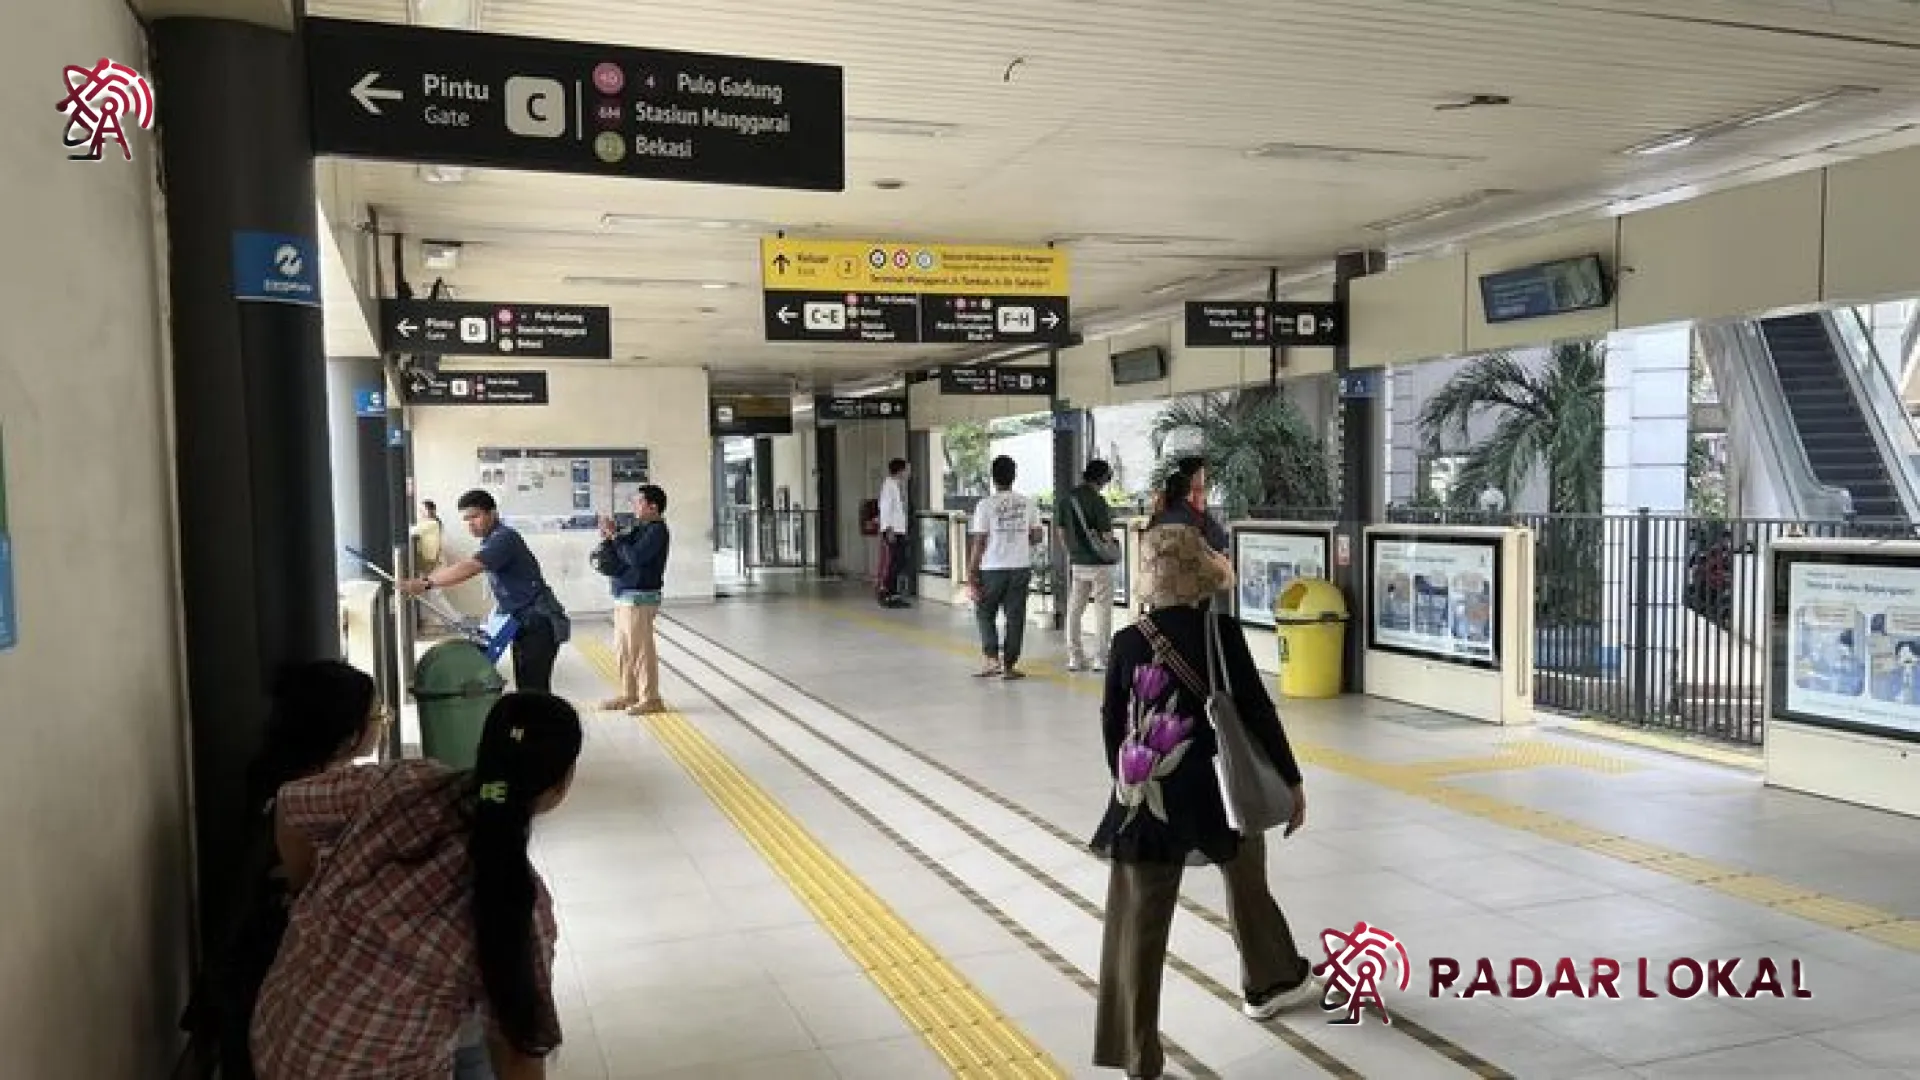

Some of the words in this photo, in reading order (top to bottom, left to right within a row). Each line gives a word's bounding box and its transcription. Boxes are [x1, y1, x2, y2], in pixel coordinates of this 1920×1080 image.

[423, 73, 489, 100] Pintu
[676, 73, 717, 95] Pulo
[719, 76, 783, 105] Gadung
[425, 104, 470, 126] Gate
[526, 92, 549, 122] C
[635, 101, 698, 125] Stasiun
[701, 107, 791, 135] Manggarai
[635, 134, 692, 158] Bekasi
[811, 308, 840, 324] C-E
[1003, 312, 1031, 326] F-H
